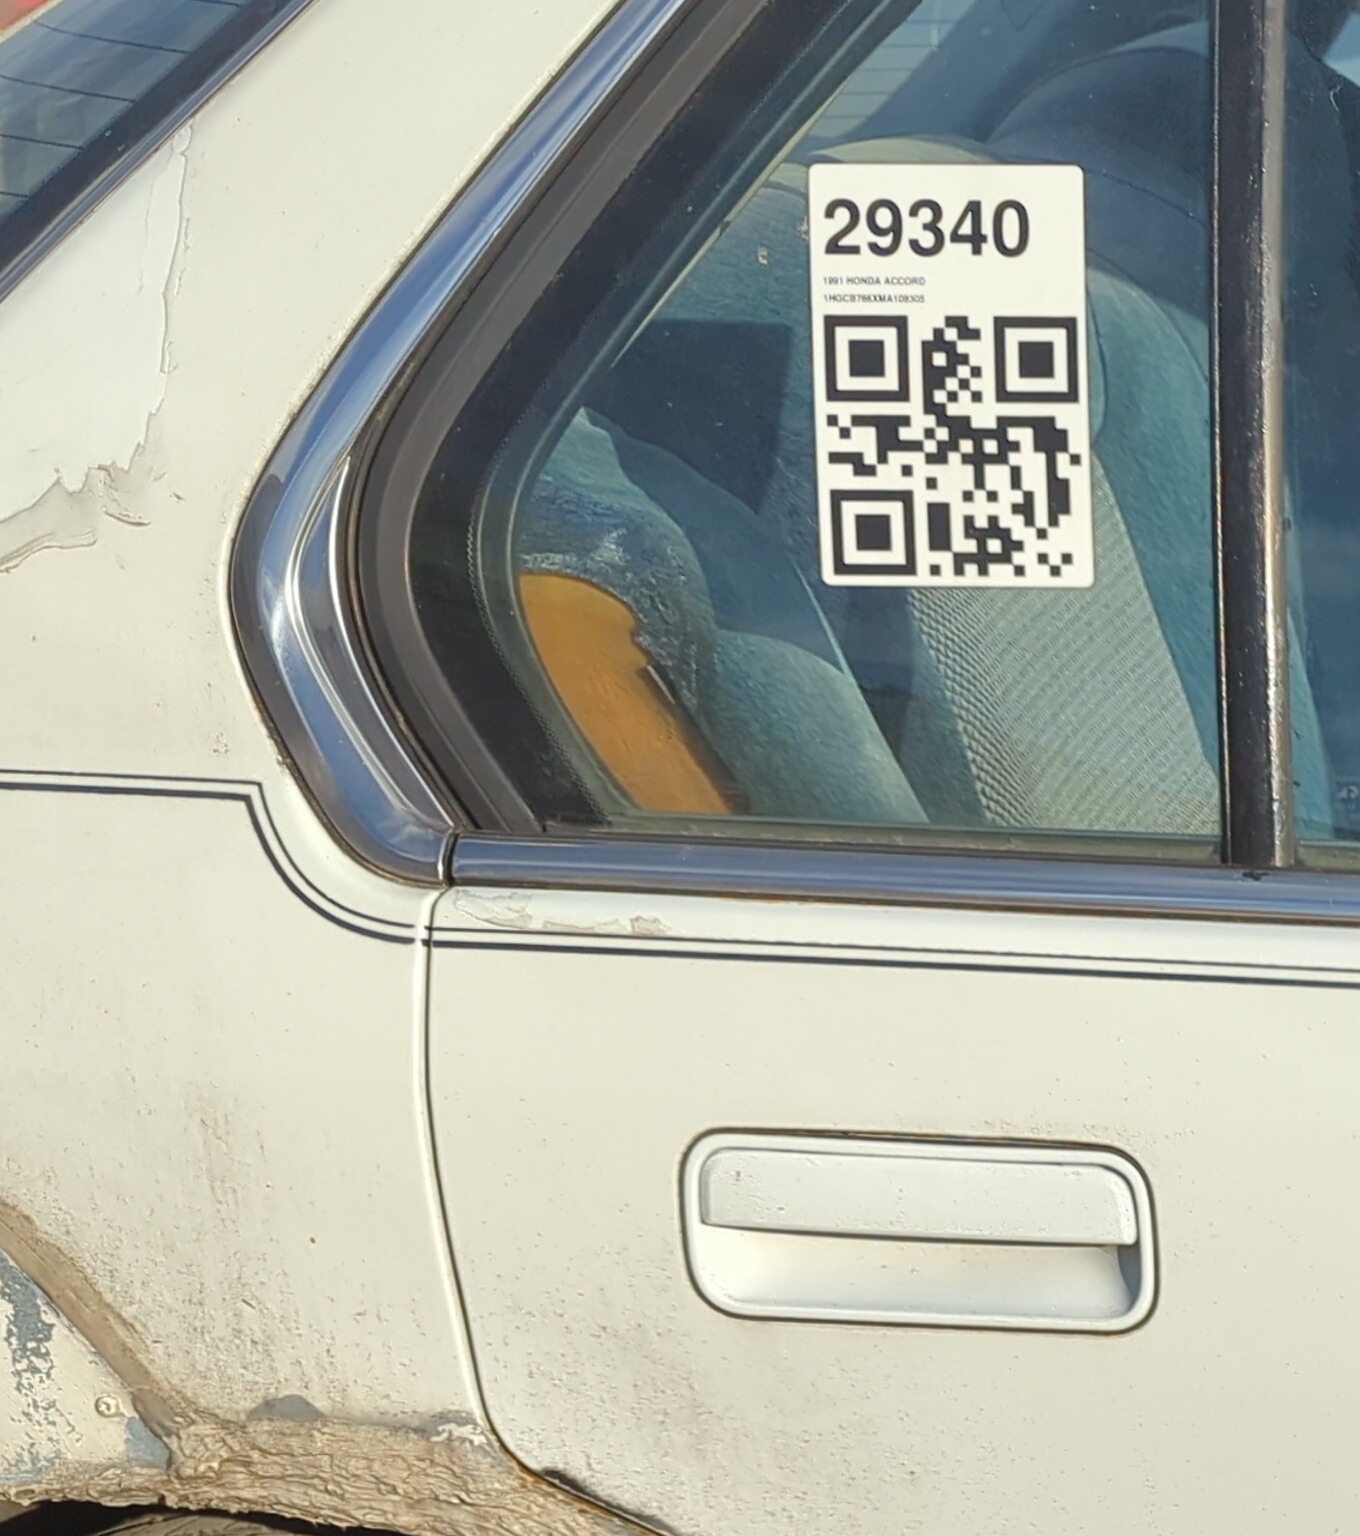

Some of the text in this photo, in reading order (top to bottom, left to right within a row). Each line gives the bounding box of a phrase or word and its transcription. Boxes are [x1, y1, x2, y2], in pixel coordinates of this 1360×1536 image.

[824, 198, 1030, 257] 29340
[823, 276, 925, 286] 1991 HONDA ACCORD
